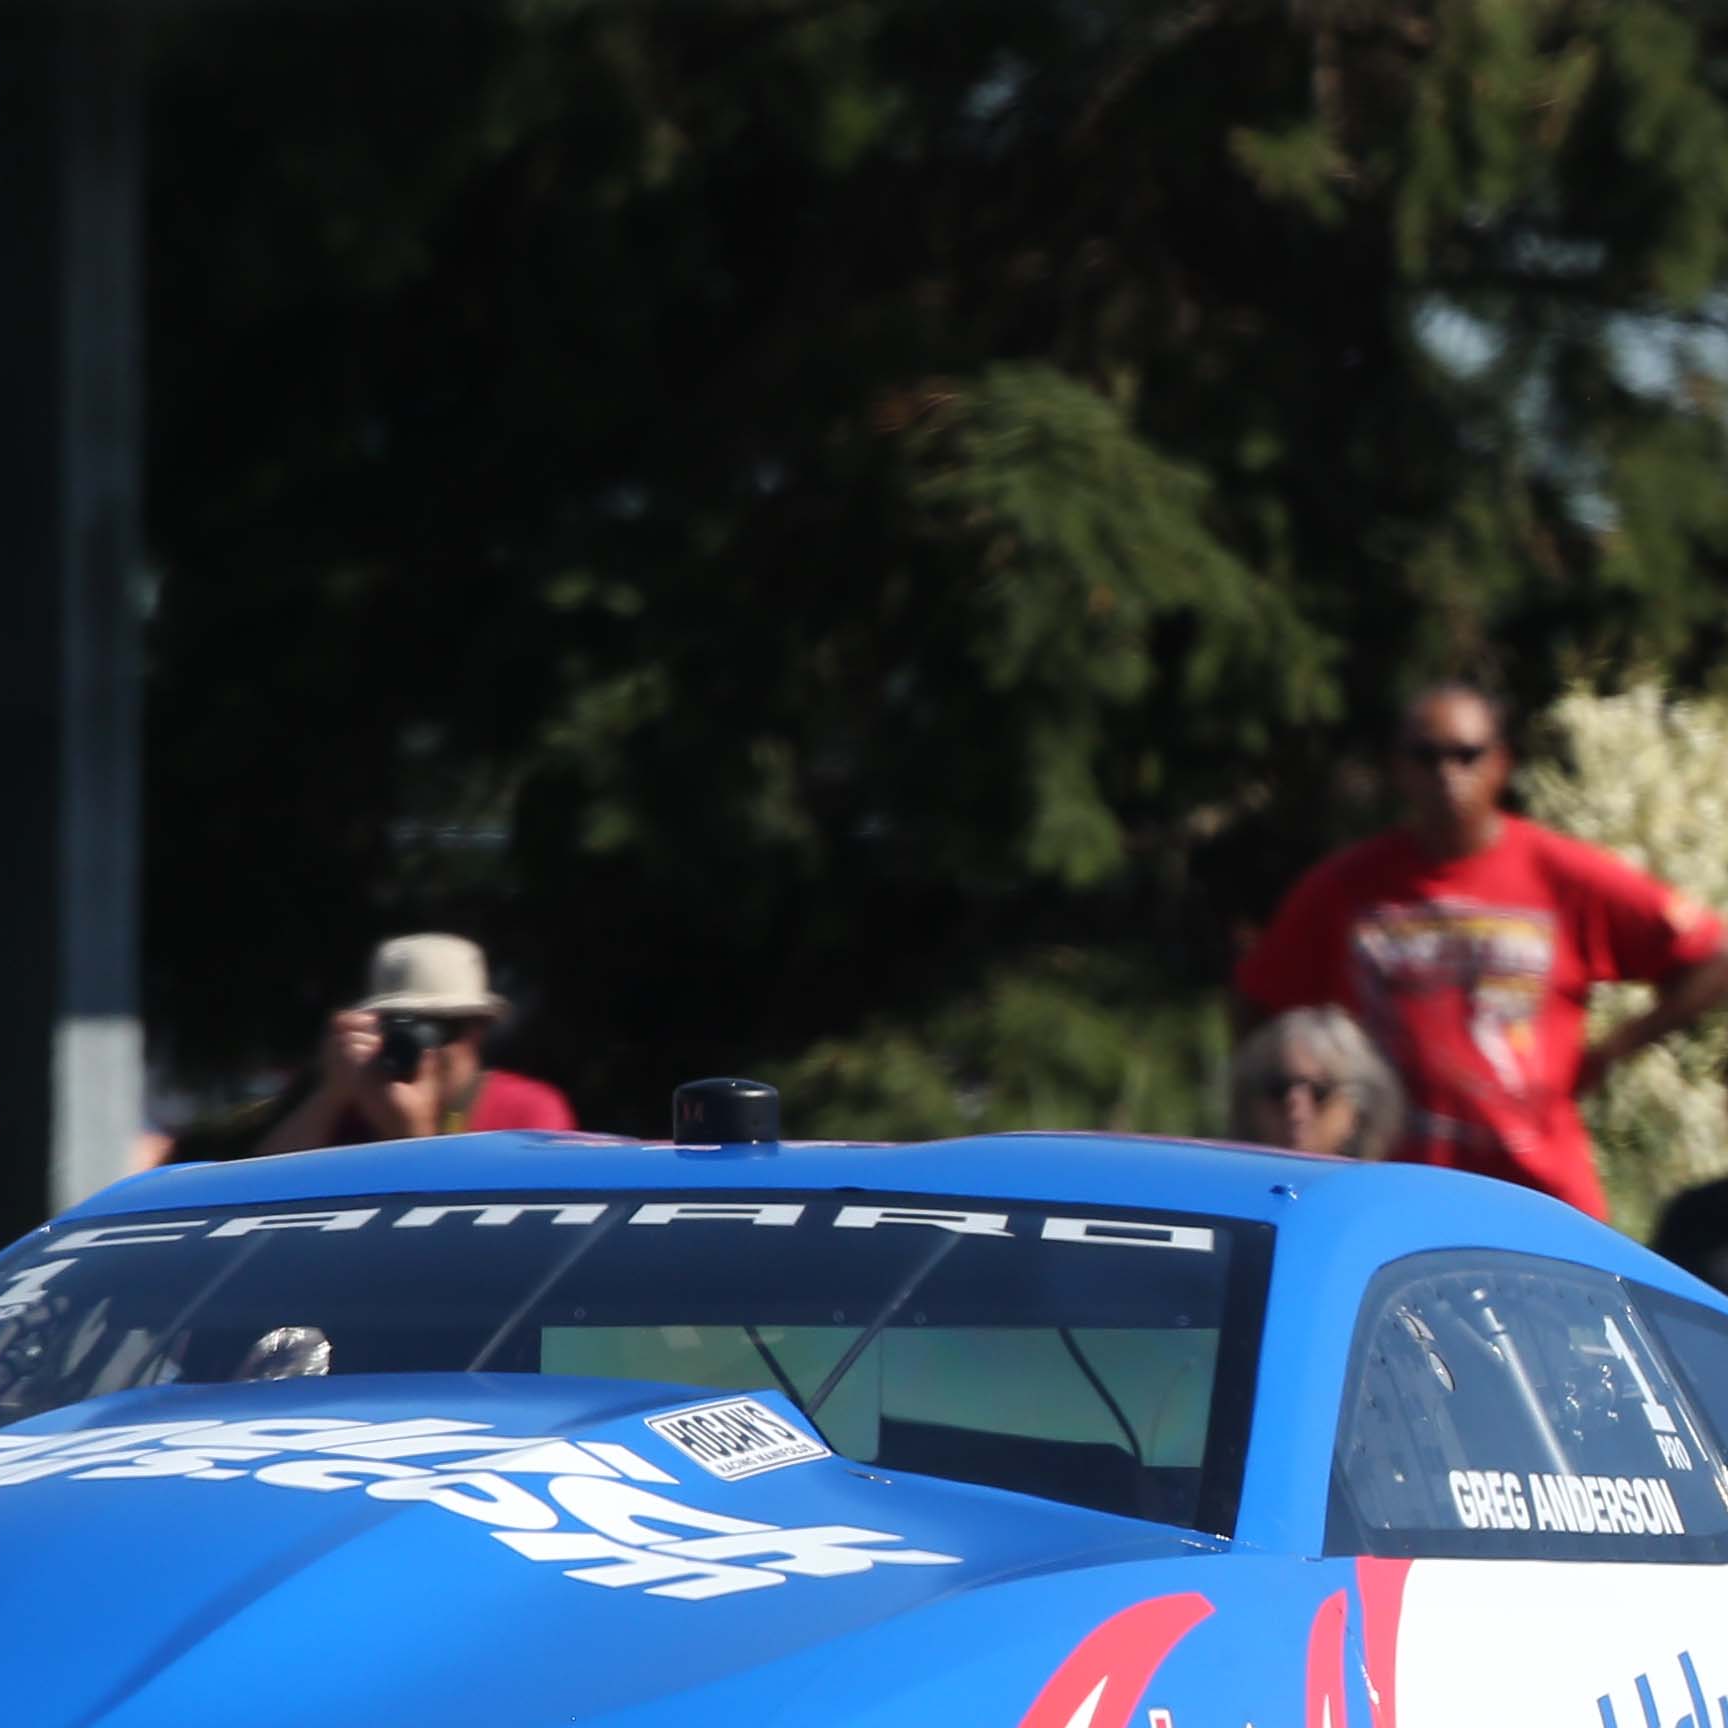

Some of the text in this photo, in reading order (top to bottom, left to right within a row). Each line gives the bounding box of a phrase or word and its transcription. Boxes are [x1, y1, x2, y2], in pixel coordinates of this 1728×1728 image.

[42, 1204, 1214, 1253] CAMARO
[1603, 1315, 1677, 1432] 1
[660, 1404, 798, 1463] HOGAN'S
[1655, 1434, 1693, 1471] PRO
[1449, 1469, 1532, 1531] GREG
[1536, 1473, 1685, 1535] ANDERSON
